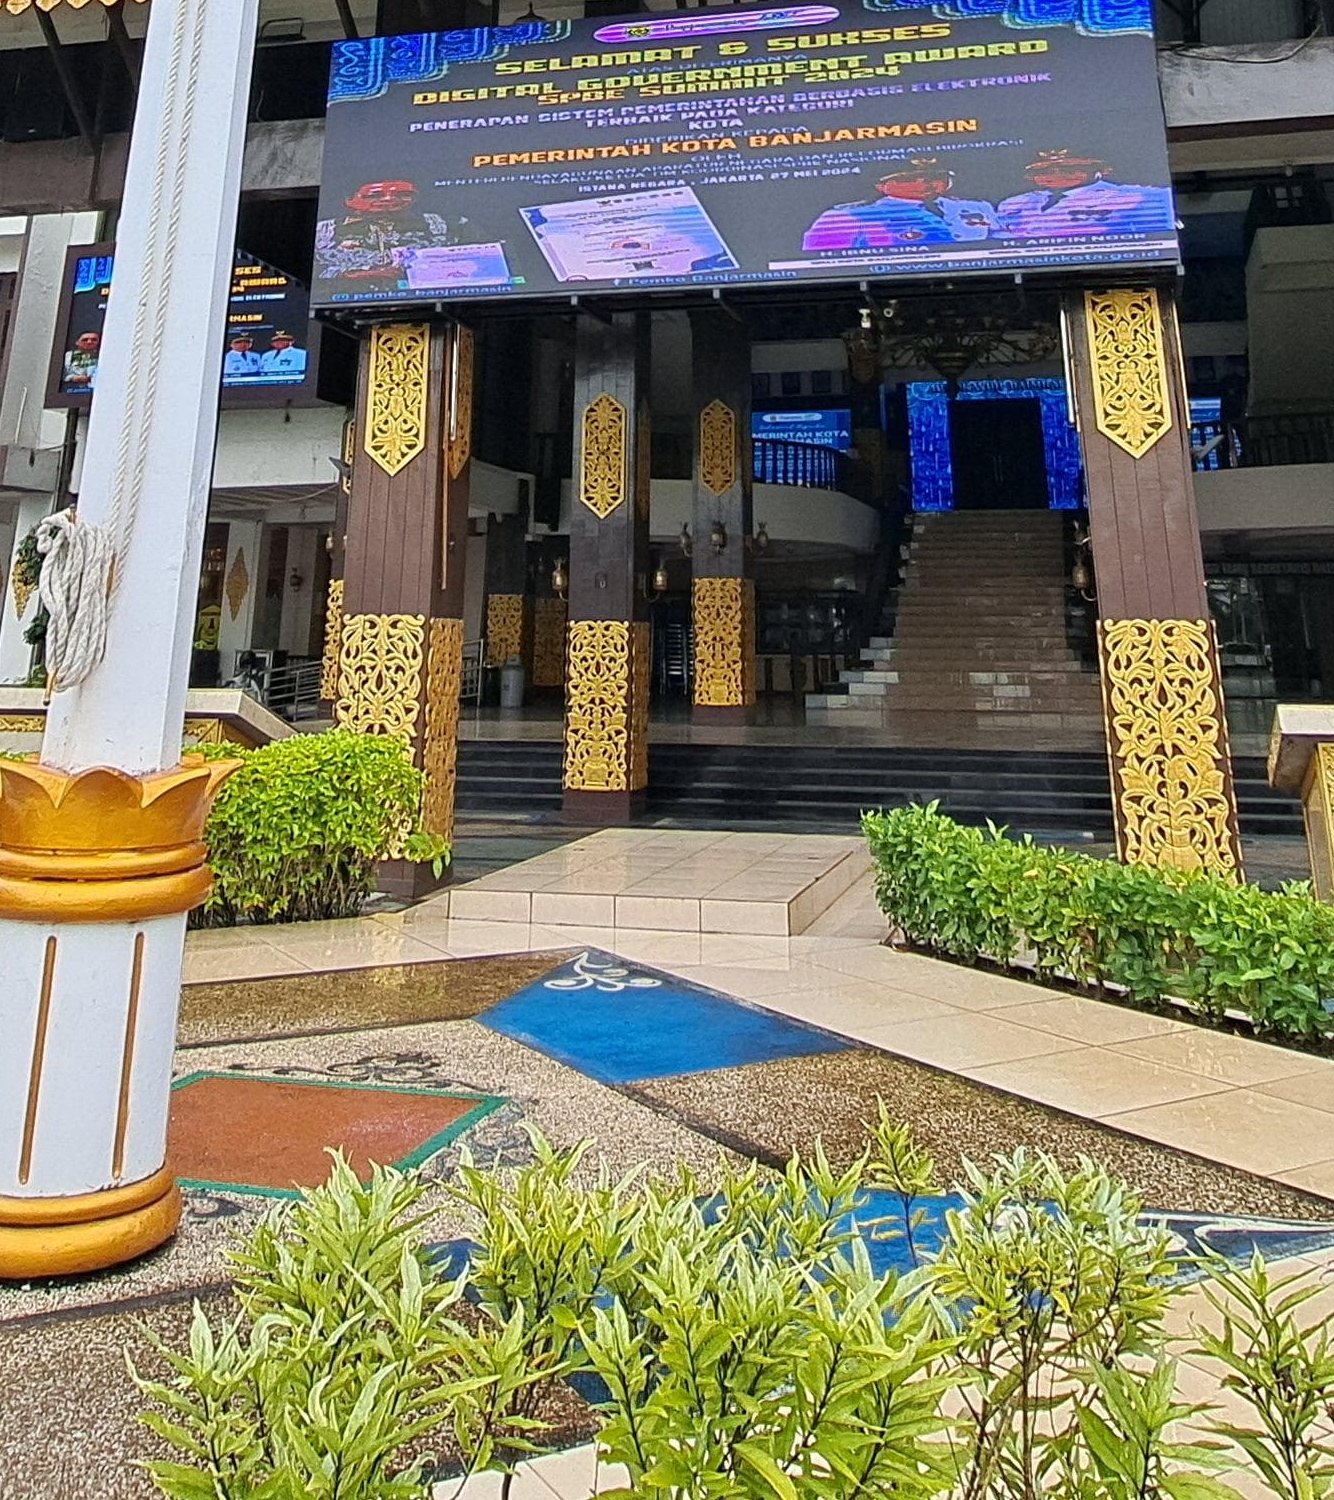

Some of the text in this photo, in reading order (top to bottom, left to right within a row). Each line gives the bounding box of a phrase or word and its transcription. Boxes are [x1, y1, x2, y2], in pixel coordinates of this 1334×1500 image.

[495, 23, 952, 76] SELAMAT & SUKSES
[413, 39, 1049, 106] DIGITAL GOVERNMENT AWARD
[537, 65, 901, 106] SPBE SUMMIT 2024
[410, 72, 1052, 133] PENERAPAN SISTEM PEMERINTAHAN BERBASIS ELEKTRONIK
[585, 99, 855, 129] TERBAIK PADA KATEGORI
[688, 117, 745, 130] KOTA
[472, 118, 979, 168] PEMERINTAH KOTA BANJARMASIN
[578, 182, 627, 193] ISTANA
[631, 178, 686, 189] NEGARA
[700, 174, 764, 185] JAKARTA
[794, 167, 818, 178] MEI
[821, 166, 861, 176] 2024
[235, 266, 262, 276] SES
[229, 314, 263, 322] MASIN
[752, 430, 849, 439] MERINTAH KOTA
